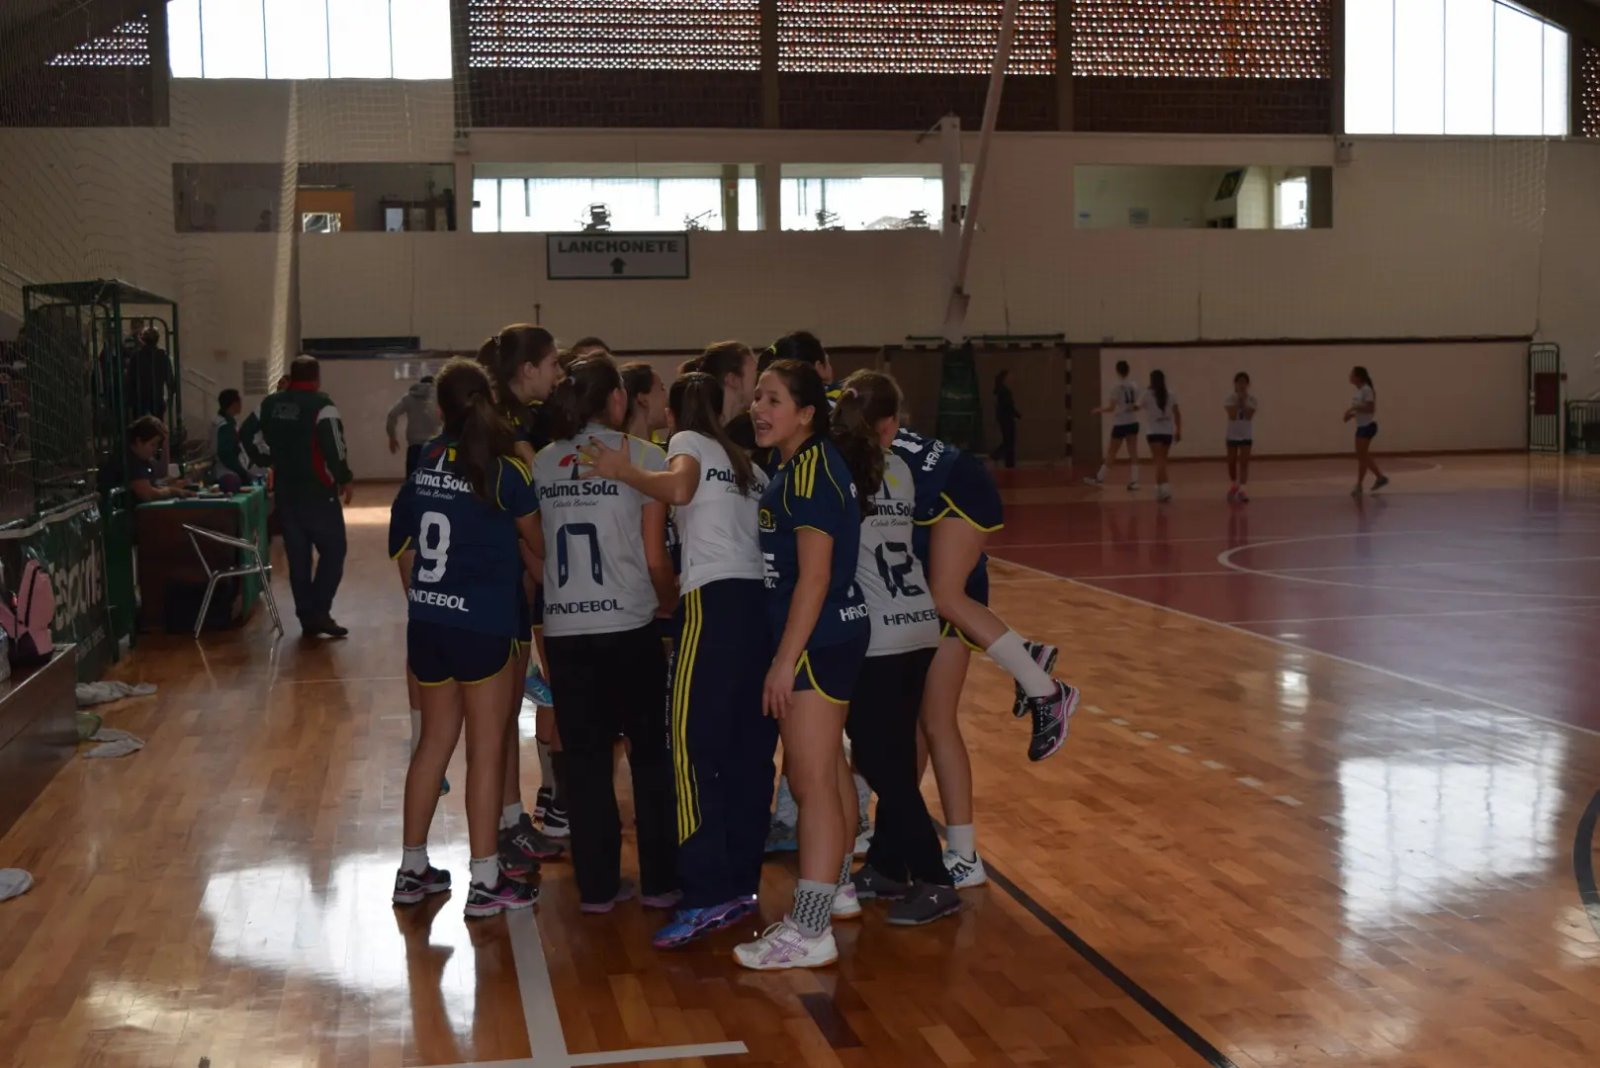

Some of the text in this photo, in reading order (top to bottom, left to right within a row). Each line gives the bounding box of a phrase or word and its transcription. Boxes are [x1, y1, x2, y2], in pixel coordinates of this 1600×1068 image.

[558, 240, 679, 253] LANCHONETE
[539, 480, 619, 500] Palma Sola
[417, 511, 450, 583] 9
[544, 598, 625, 615] HANDEBOL
